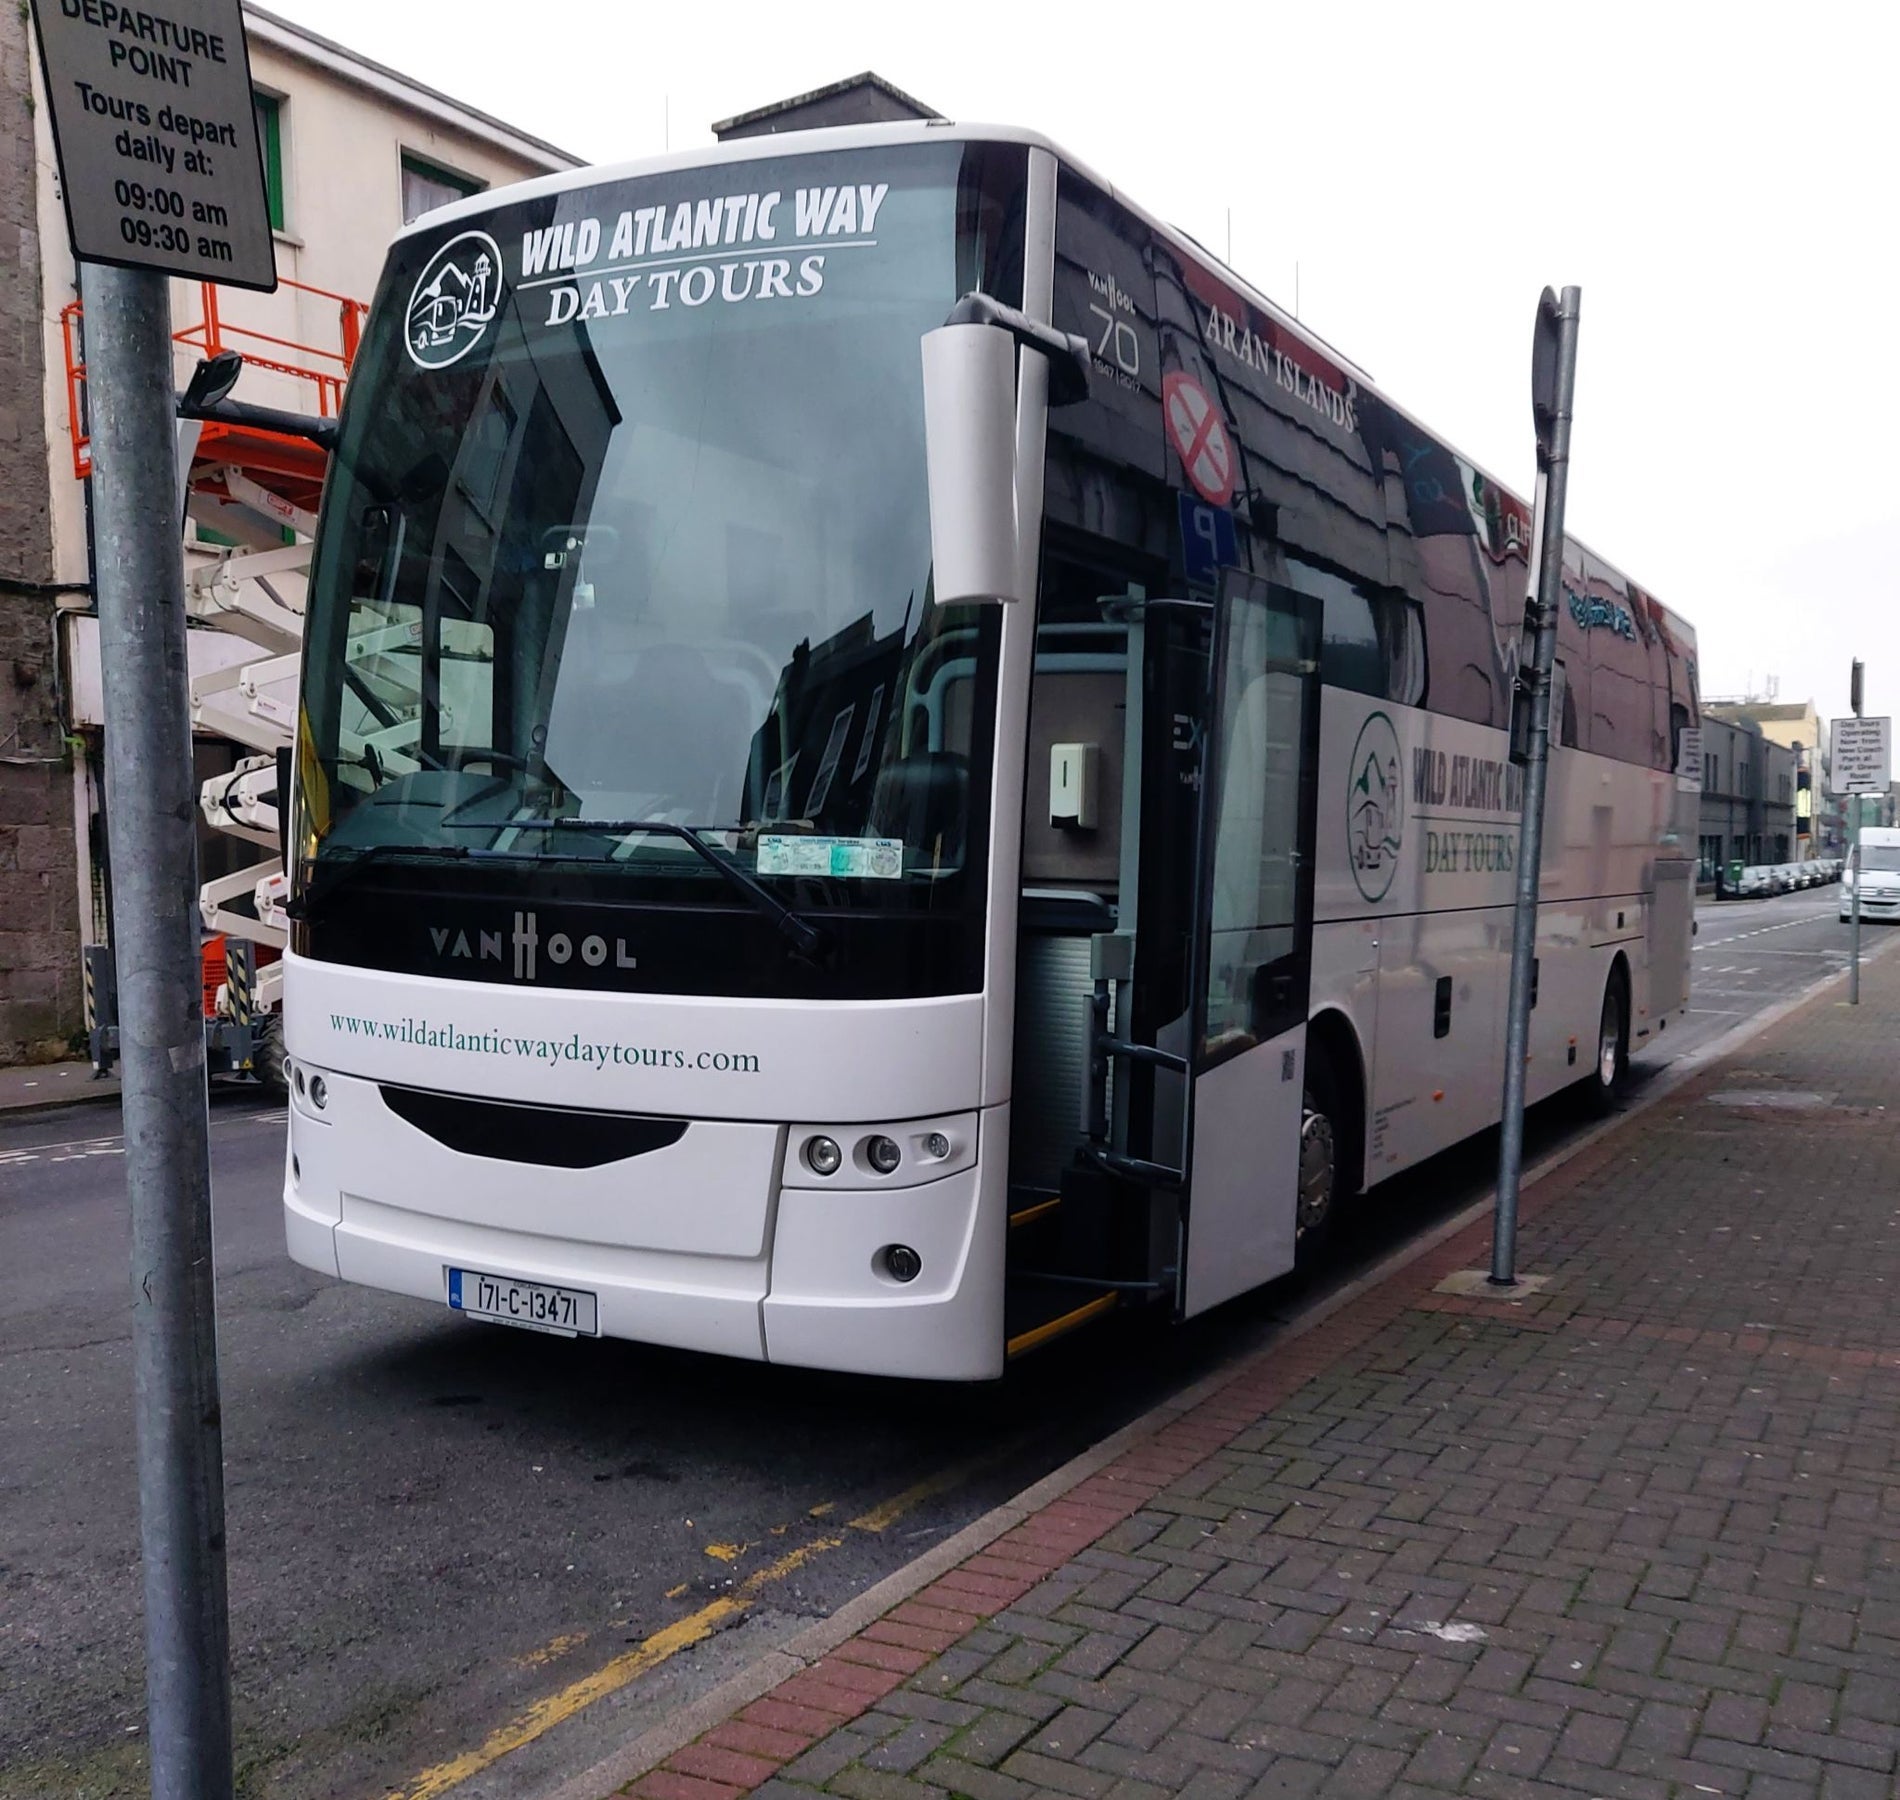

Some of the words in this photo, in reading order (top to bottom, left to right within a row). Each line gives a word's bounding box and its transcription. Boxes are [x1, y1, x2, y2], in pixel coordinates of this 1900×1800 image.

[61, 0, 227, 63] DEPARTURE
[109, 40, 192, 87] POINT
[74, 81, 151, 126] Tours
[158, 105, 237, 148] depart
[115, 130, 175, 173] daily
[184, 150, 214, 176] at:
[115, 179, 184, 218] 09:00
[192, 200, 228, 227] am
[521, 216, 601, 277] WILD
[607, 191, 781, 260] ATLANTIC
[795, 183, 889, 237] WAY
[120, 217, 189, 253] 09:30
[197, 236, 233, 262] am
[545, 276, 642, 327] DAY
[648, 255, 825, 311] TOURS
[1090, 302, 1139, 376] 70
[1205, 304, 1269, 376] ARAN
[1274, 349, 1354, 433] ISLANDS
[1413, 747, 1446, 805] WILD
[1449, 754, 1503, 811] ATLANTIC
[1505, 763, 1523, 812] WA
[1425, 832, 1462, 873] DAY
[1463, 833, 1514, 872] TOURS
[329, 1013, 761, 1074] www.wildatlanticwaydaytours.com
[478, 1281, 577, 1326] 171-C-13471
